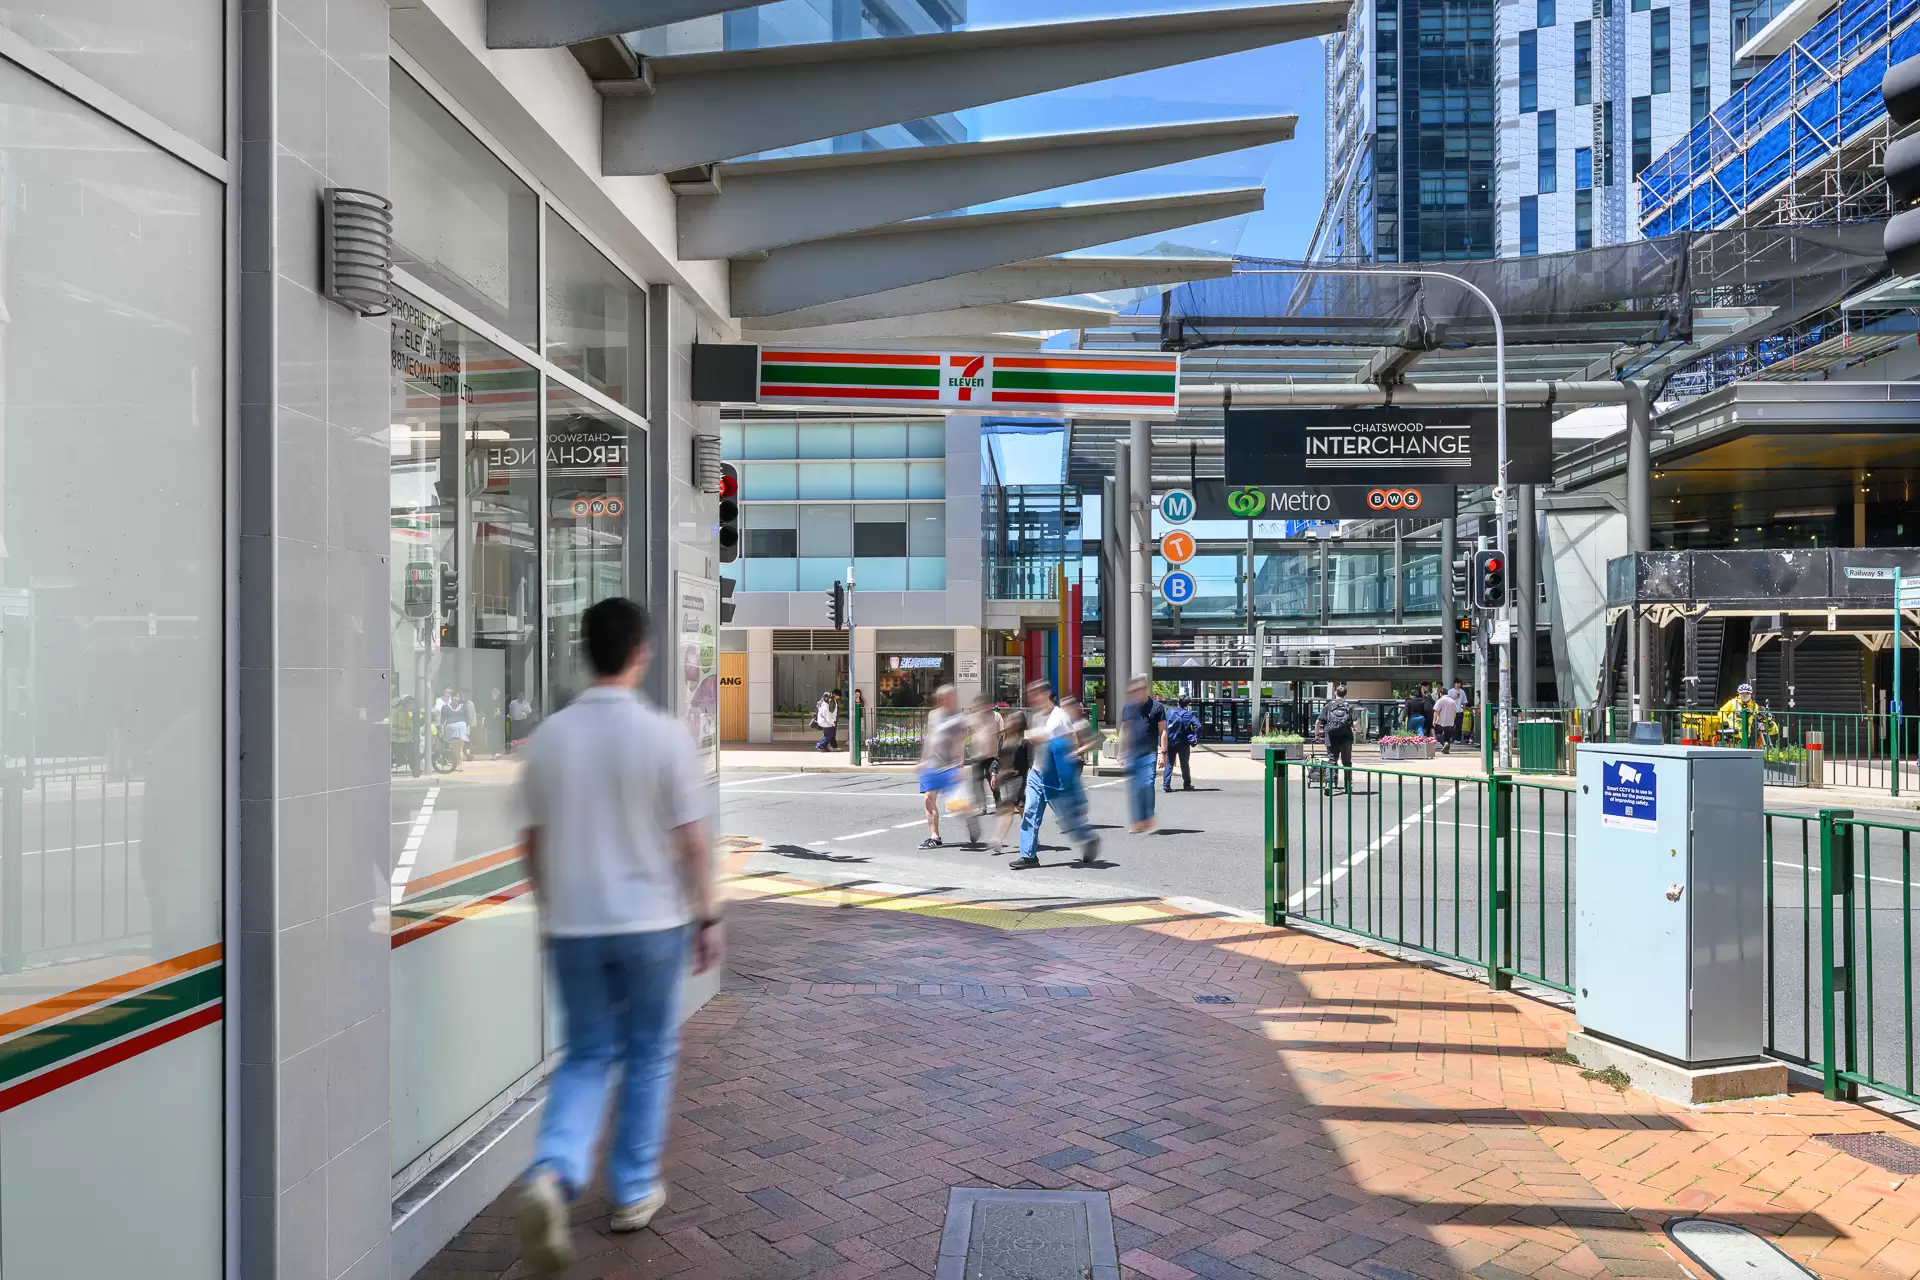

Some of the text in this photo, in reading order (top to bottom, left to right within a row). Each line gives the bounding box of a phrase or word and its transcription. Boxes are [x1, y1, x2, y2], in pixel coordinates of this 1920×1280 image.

[1352, 423, 1424, 433] CHATSWOOD
[1305, 435, 1471, 455] INTERCHANGE
[1168, 497, 1188, 517] M
[1270, 491, 1331, 512] Metro
[1168, 537, 1184, 558] T
[1849, 569, 1876, 578] Railway
[1171, 578, 1187, 598] B
